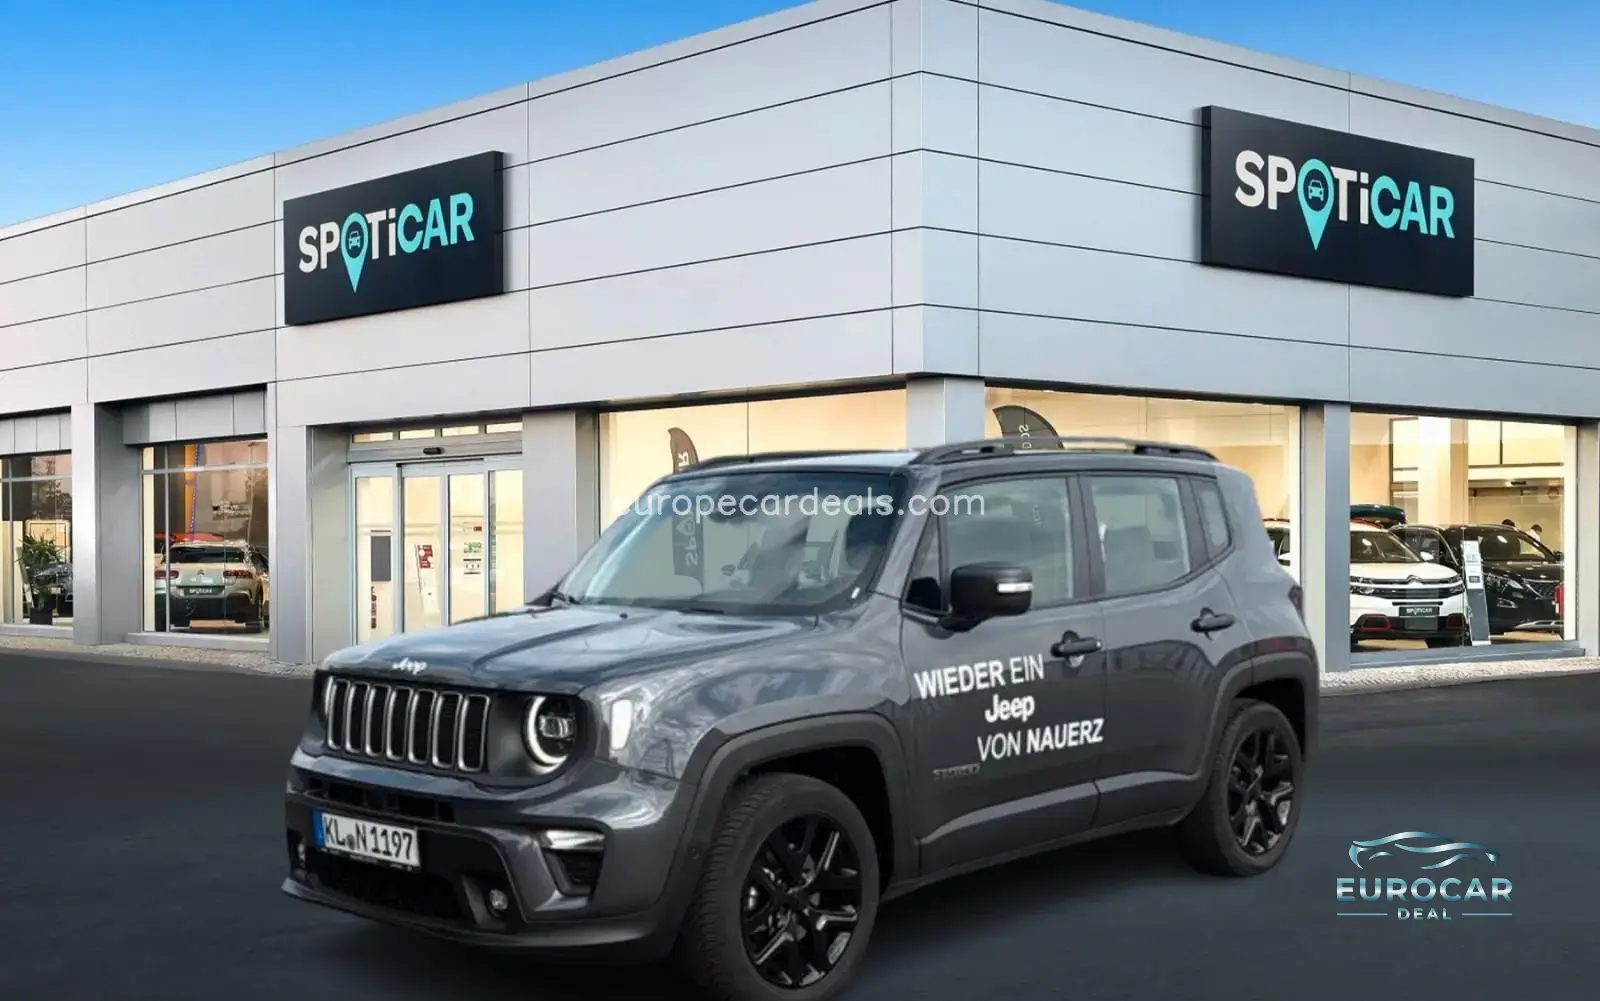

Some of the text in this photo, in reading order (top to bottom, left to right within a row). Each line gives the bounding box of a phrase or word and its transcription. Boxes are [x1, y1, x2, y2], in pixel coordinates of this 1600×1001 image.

[913, 653, 1045, 700] WIEDER EIN
[984, 693, 1036, 723] Jeep
[977, 717, 1105, 763] VON NAUERZ
